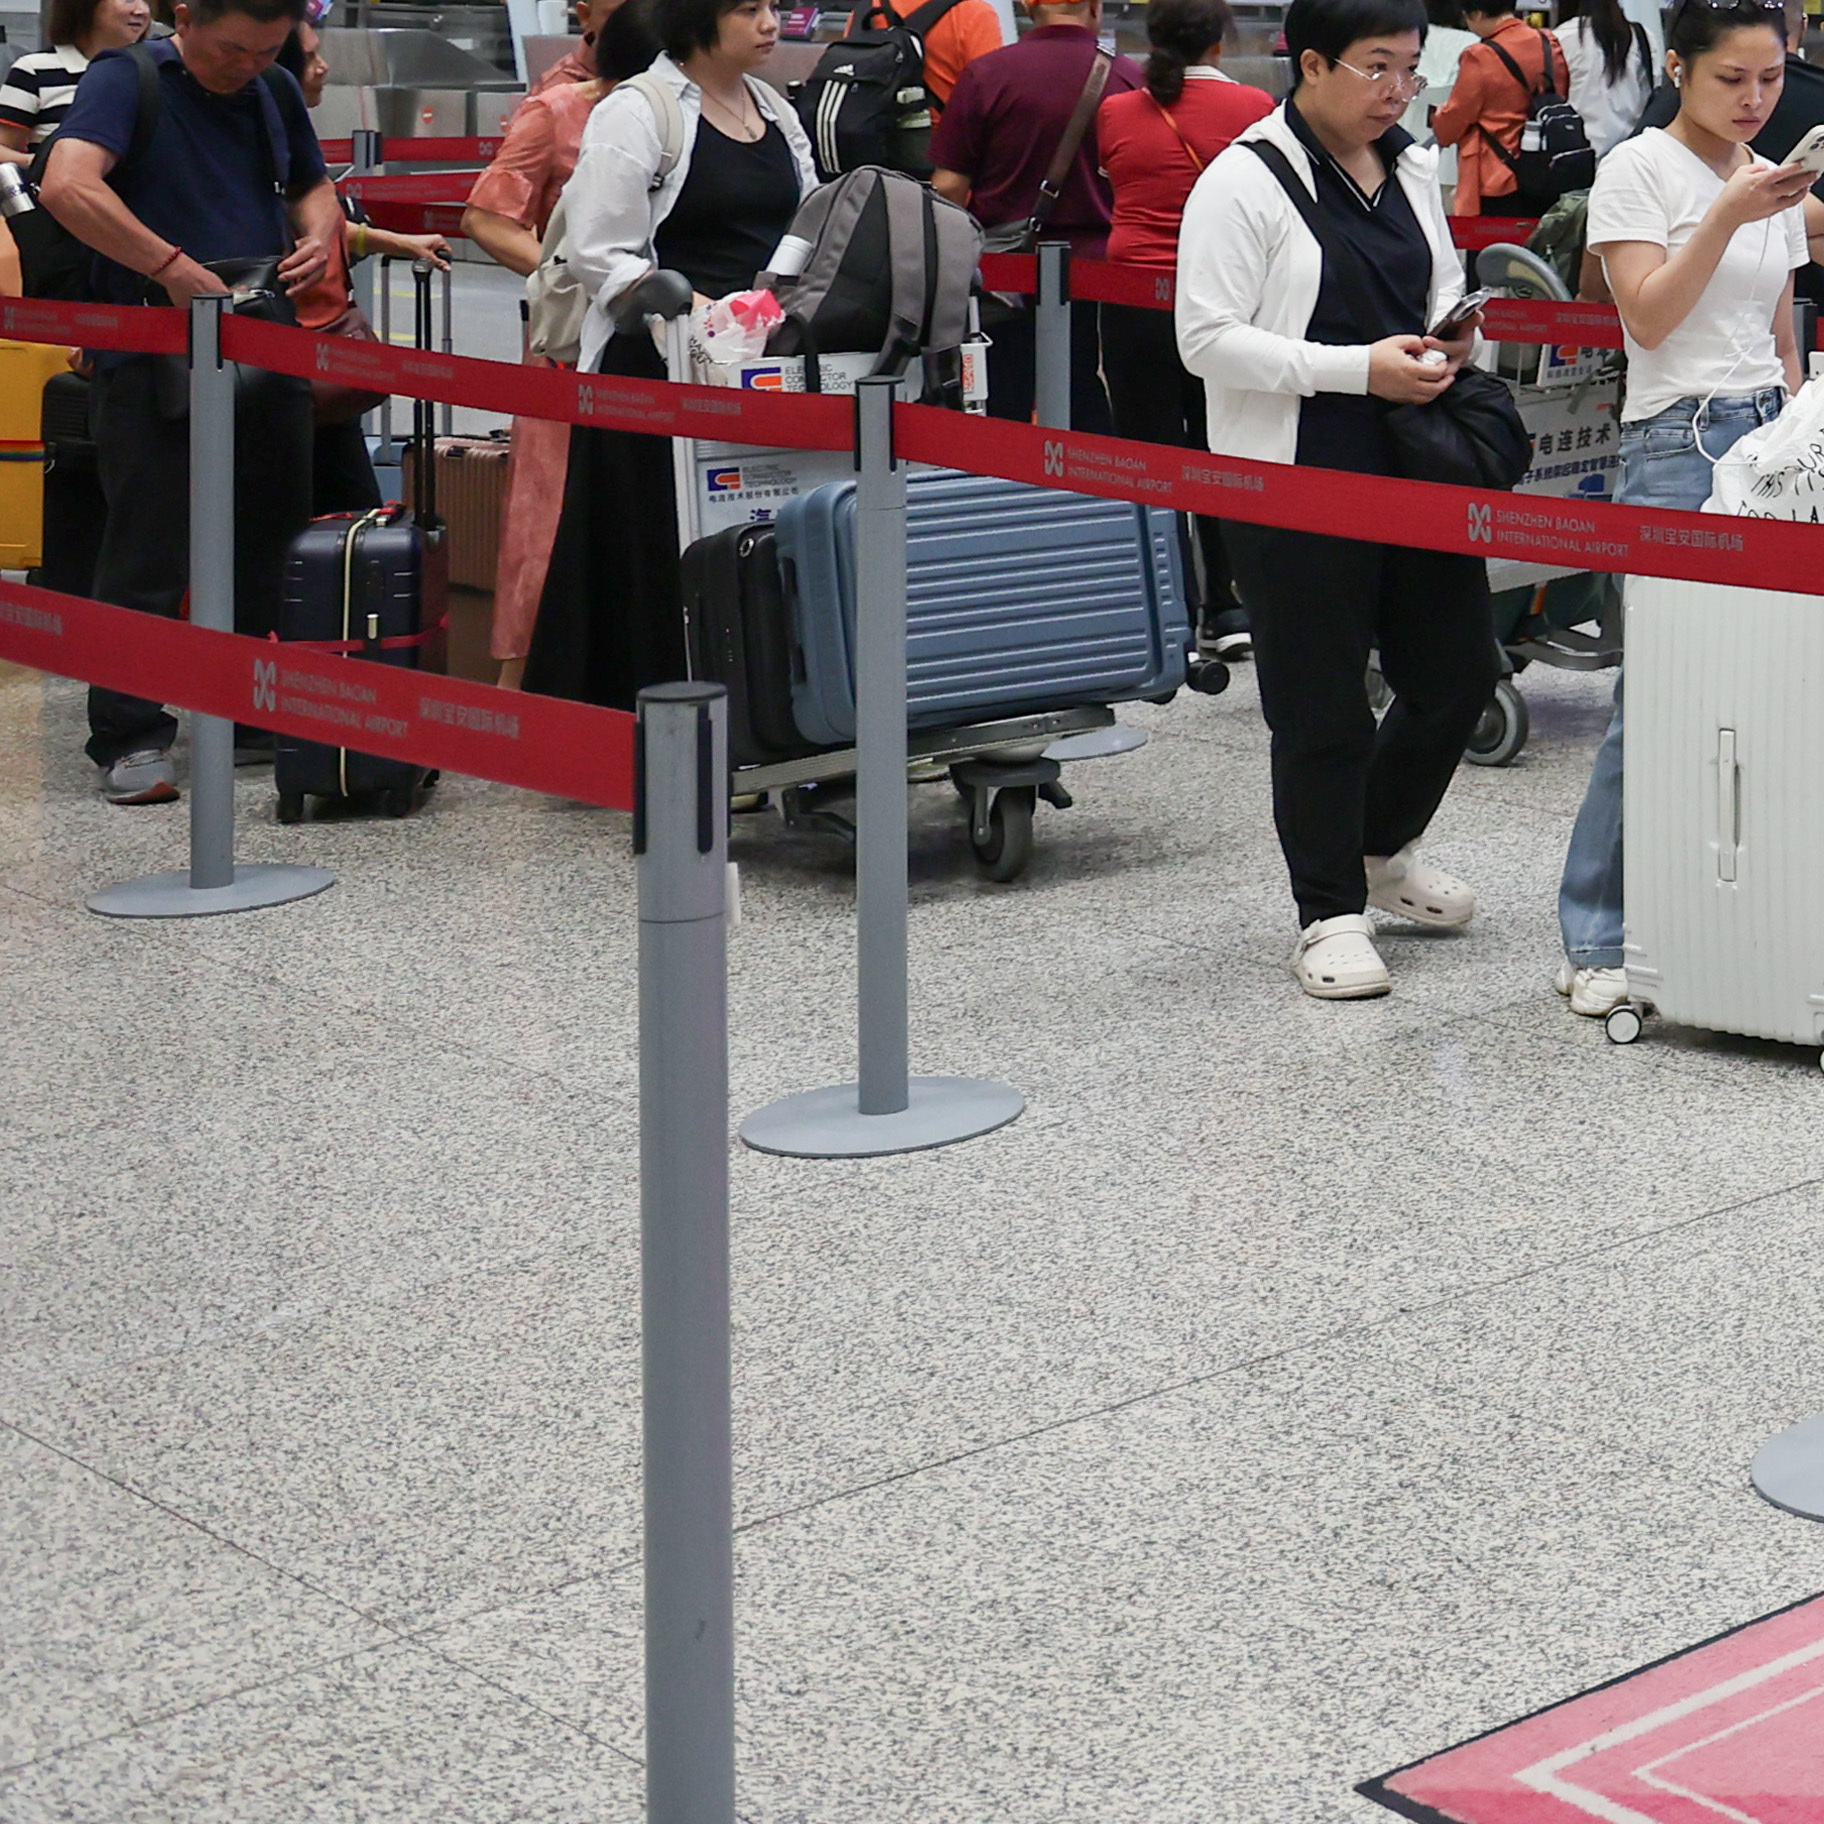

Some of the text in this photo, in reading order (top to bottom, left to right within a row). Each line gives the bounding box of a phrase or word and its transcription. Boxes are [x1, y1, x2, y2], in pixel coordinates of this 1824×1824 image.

[1539, 422, 1611, 455] 电连技术
[1496, 509, 1595, 535] SHENZHEN BAOAN
[1496, 529, 1629, 558] INTERNATIONAL AIRPORT
[1639, 525, 1744, 552] 深圳宝安国际机场
